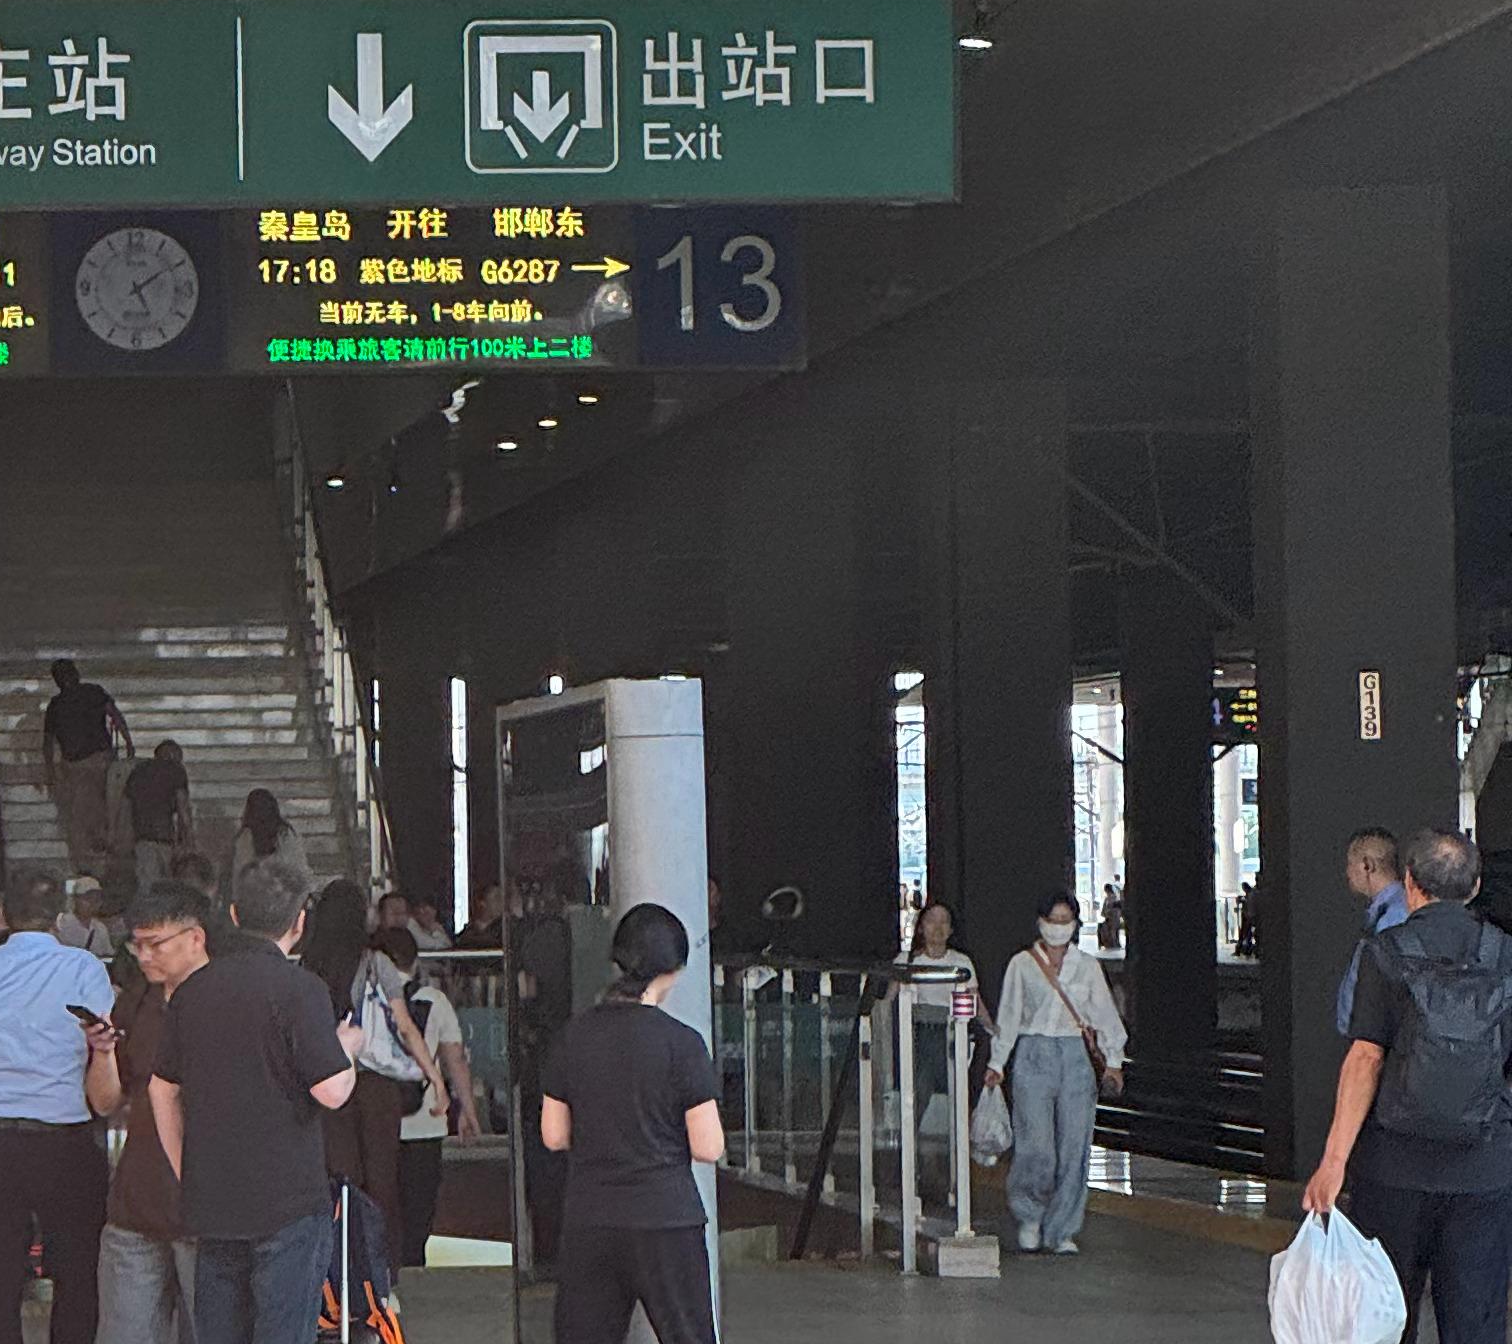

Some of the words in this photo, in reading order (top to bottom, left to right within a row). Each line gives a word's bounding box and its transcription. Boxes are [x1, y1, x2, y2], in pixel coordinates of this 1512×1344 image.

[643, 31, 874, 108] 出站口
[52, 138, 156, 166] Station
[643, 123, 721, 161] Exit
[258, 209, 351, 241] 秦皇岛
[386, 207, 449, 239] 开往
[492, 206, 585, 238] 邯郸东
[258, 258, 337, 284] 17:18
[359, 257, 464, 285] 紫色地标
[480, 258, 561, 284] G6287
[656, 235, 780, 331] 13
[1363, 674, 1378, 737] G139
